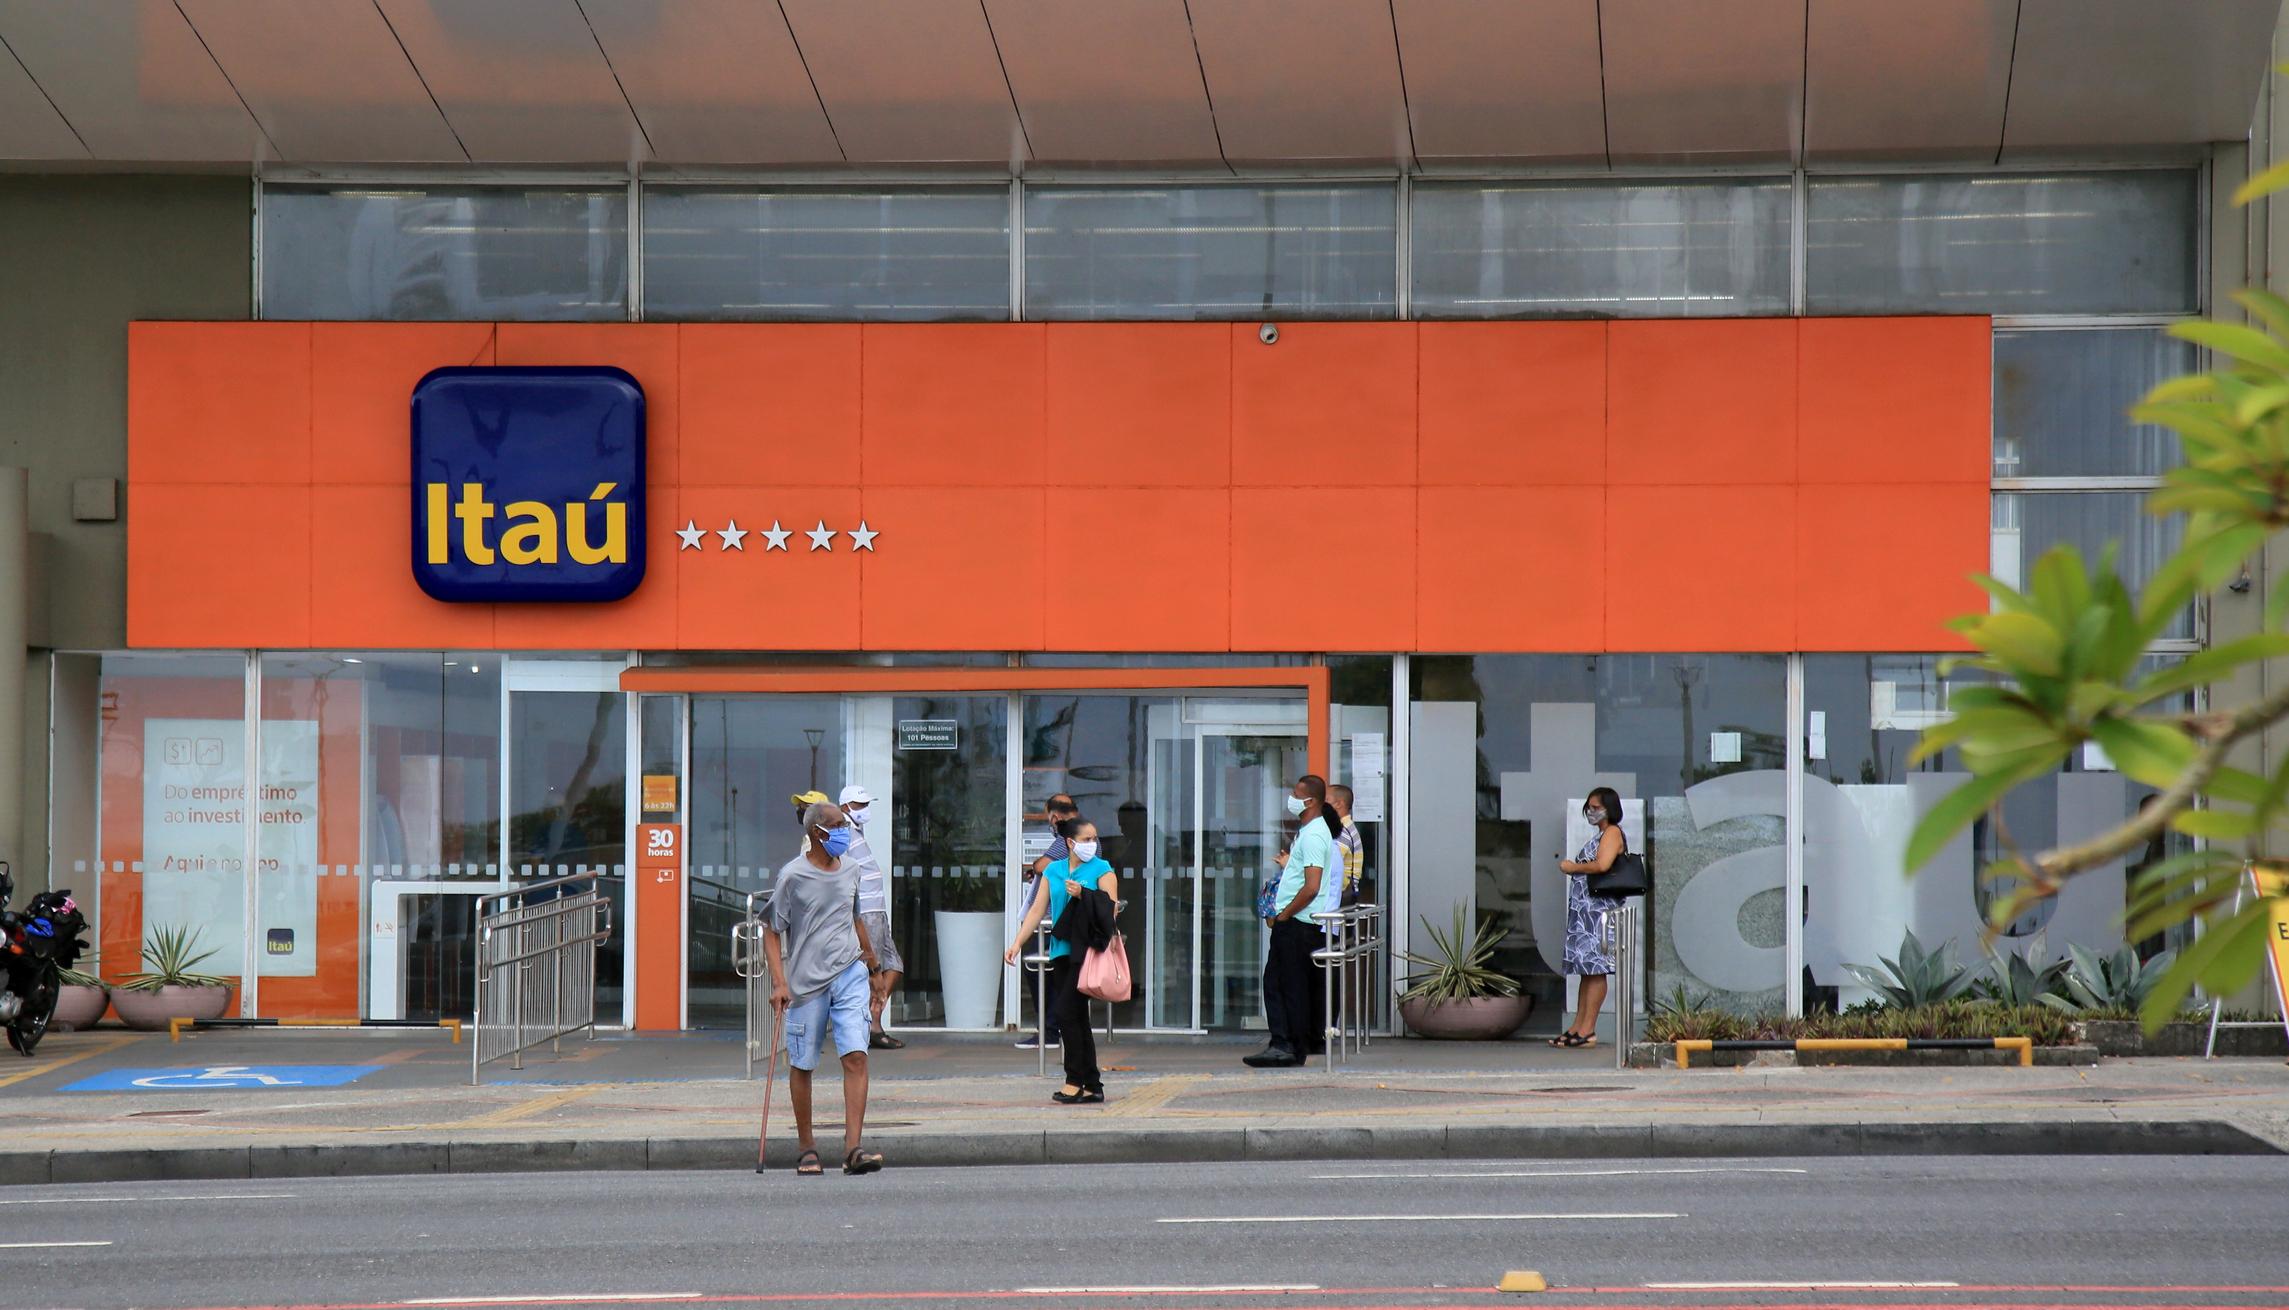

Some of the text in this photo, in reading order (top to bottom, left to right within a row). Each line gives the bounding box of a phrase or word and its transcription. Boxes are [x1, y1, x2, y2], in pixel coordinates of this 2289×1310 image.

[427, 482, 627, 565] Itaú
[164, 784, 297, 803] Do emprétimo
[163, 810, 185, 824] ao
[648, 829, 674, 847] 30
[648, 848, 674, 857] horas
[268, 940, 293, 953] Itaú
